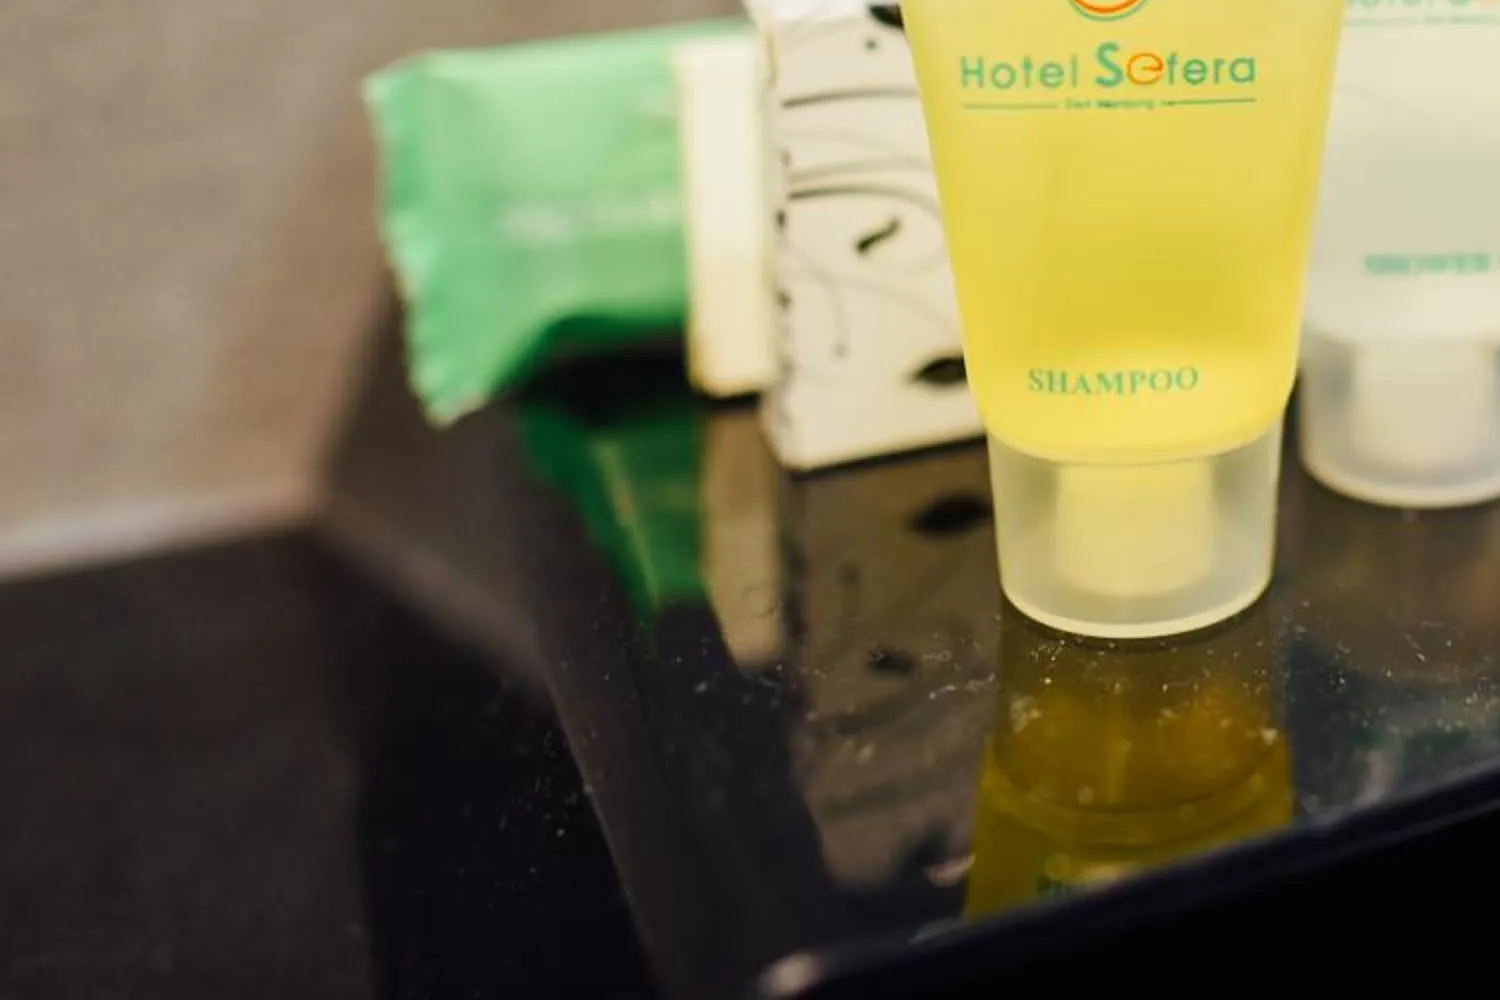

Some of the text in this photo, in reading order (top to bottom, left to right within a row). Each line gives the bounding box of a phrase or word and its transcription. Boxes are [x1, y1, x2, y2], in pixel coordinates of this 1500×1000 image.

[961, 41, 1256, 90] Hotel Sefera
[1028, 367, 1198, 396] SHAMPOO
